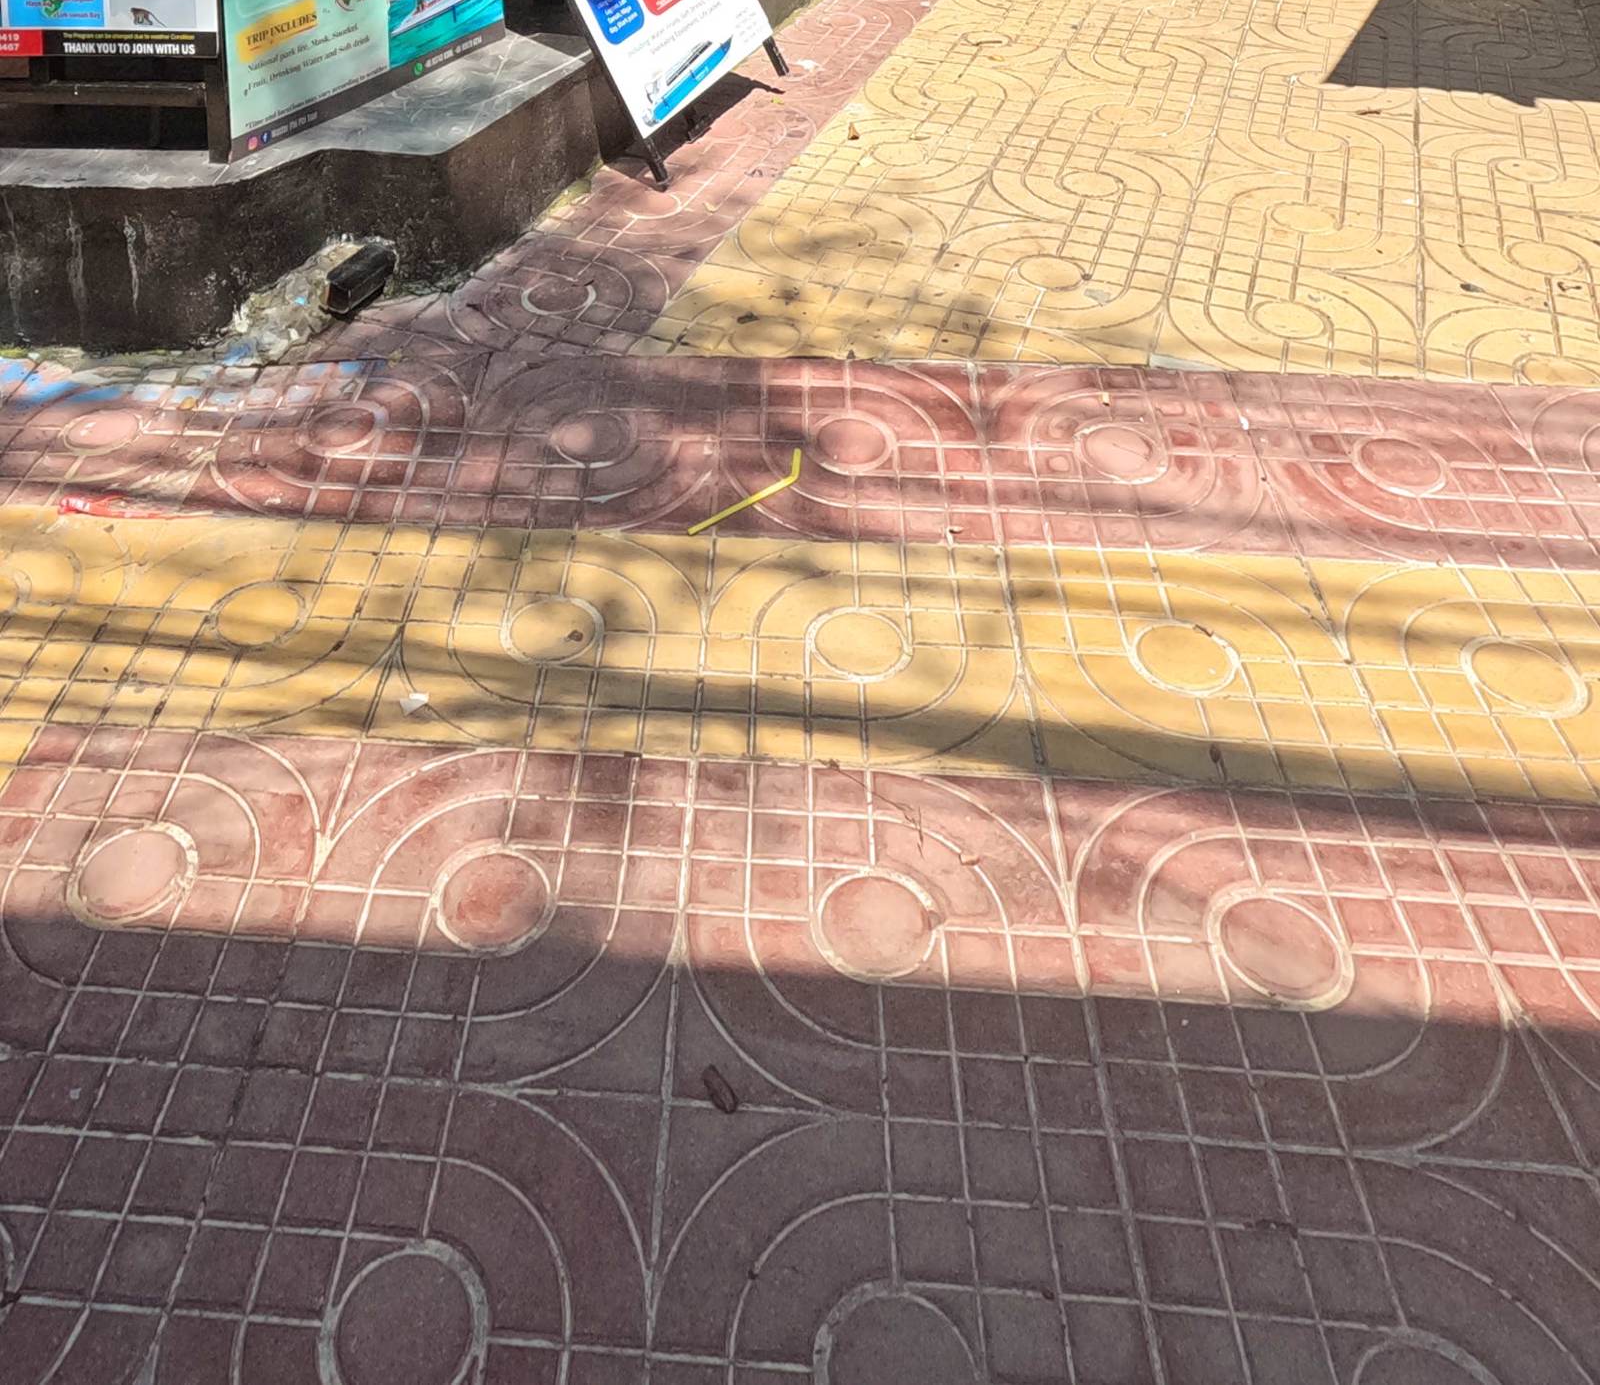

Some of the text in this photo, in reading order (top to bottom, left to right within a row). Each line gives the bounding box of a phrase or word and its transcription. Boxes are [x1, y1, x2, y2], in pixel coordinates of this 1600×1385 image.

[245, 12, 318, 45] TRIP INCLUDES
[63, 42, 195, 55] THANK YOU TO JOIN WITH US
[324, 48, 338, 61] and
[248, 53, 279, 72] National
[279, 47, 296, 63] park
